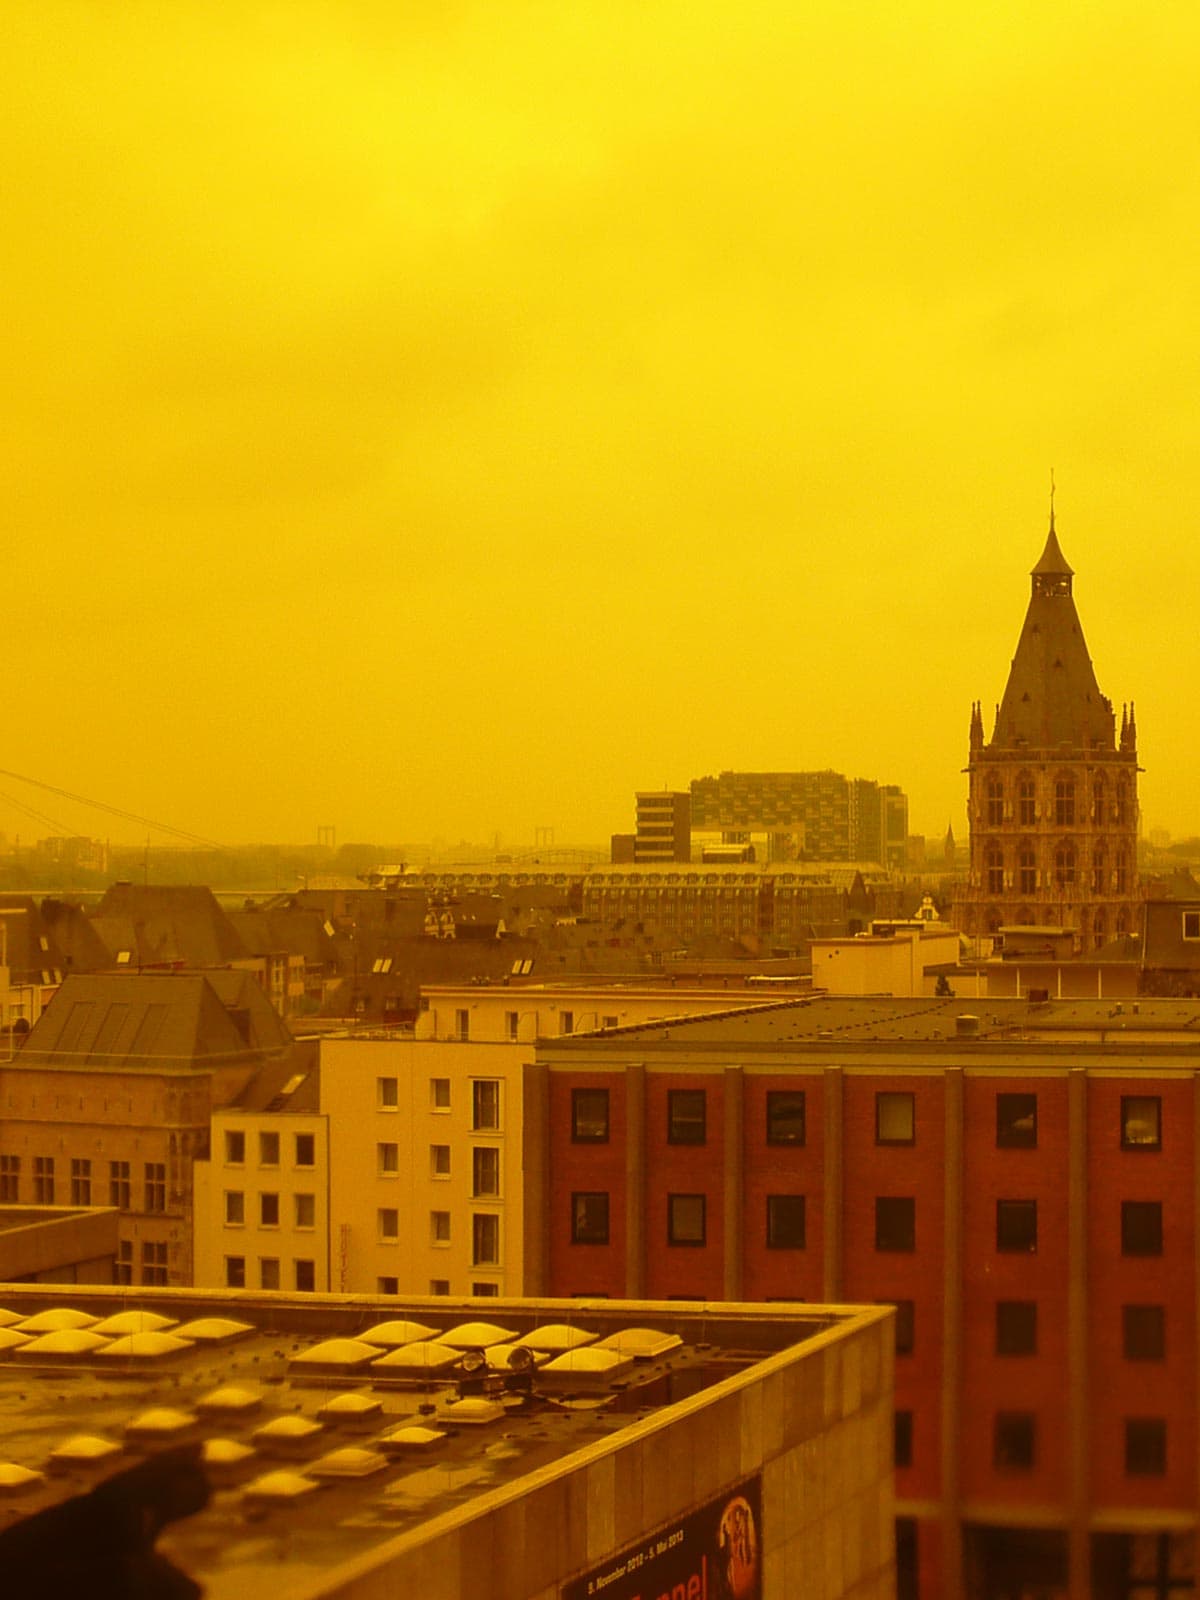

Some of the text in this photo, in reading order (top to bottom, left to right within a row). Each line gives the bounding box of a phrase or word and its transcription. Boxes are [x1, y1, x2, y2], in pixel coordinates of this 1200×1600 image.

[596, 1566, 626, 1590] November
[627, 1553, 643, 1572] 2012
[668, 1529, 683, 1548] 2013
